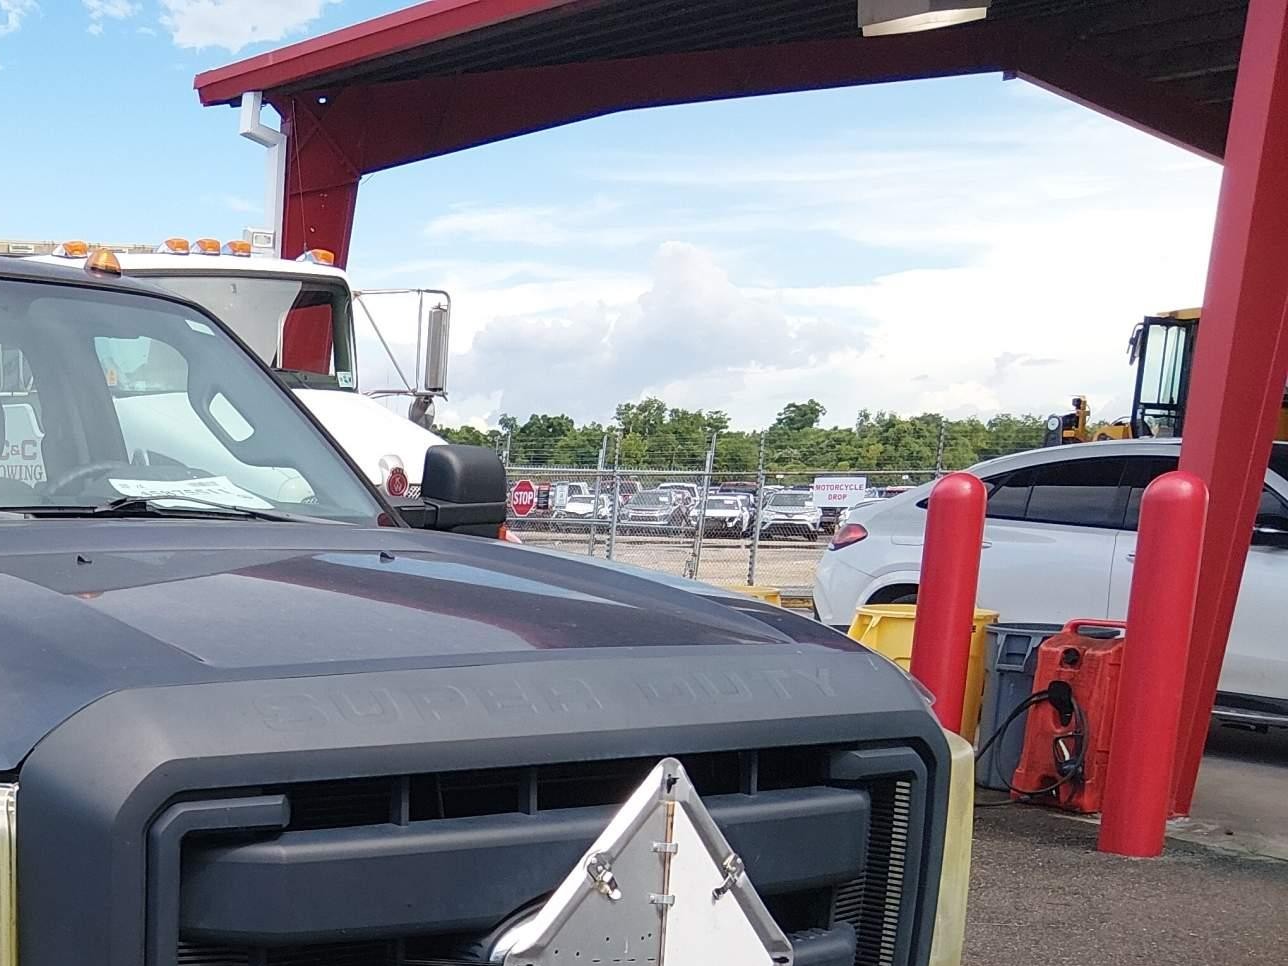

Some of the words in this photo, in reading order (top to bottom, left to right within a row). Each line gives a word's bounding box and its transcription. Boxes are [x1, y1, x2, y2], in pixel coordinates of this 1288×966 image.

[513, 491, 534, 505] STOP
[827, 493, 848, 501] DROP
[258, 680, 605, 731] SUPER
[634, 665, 838, 703] DUTY
